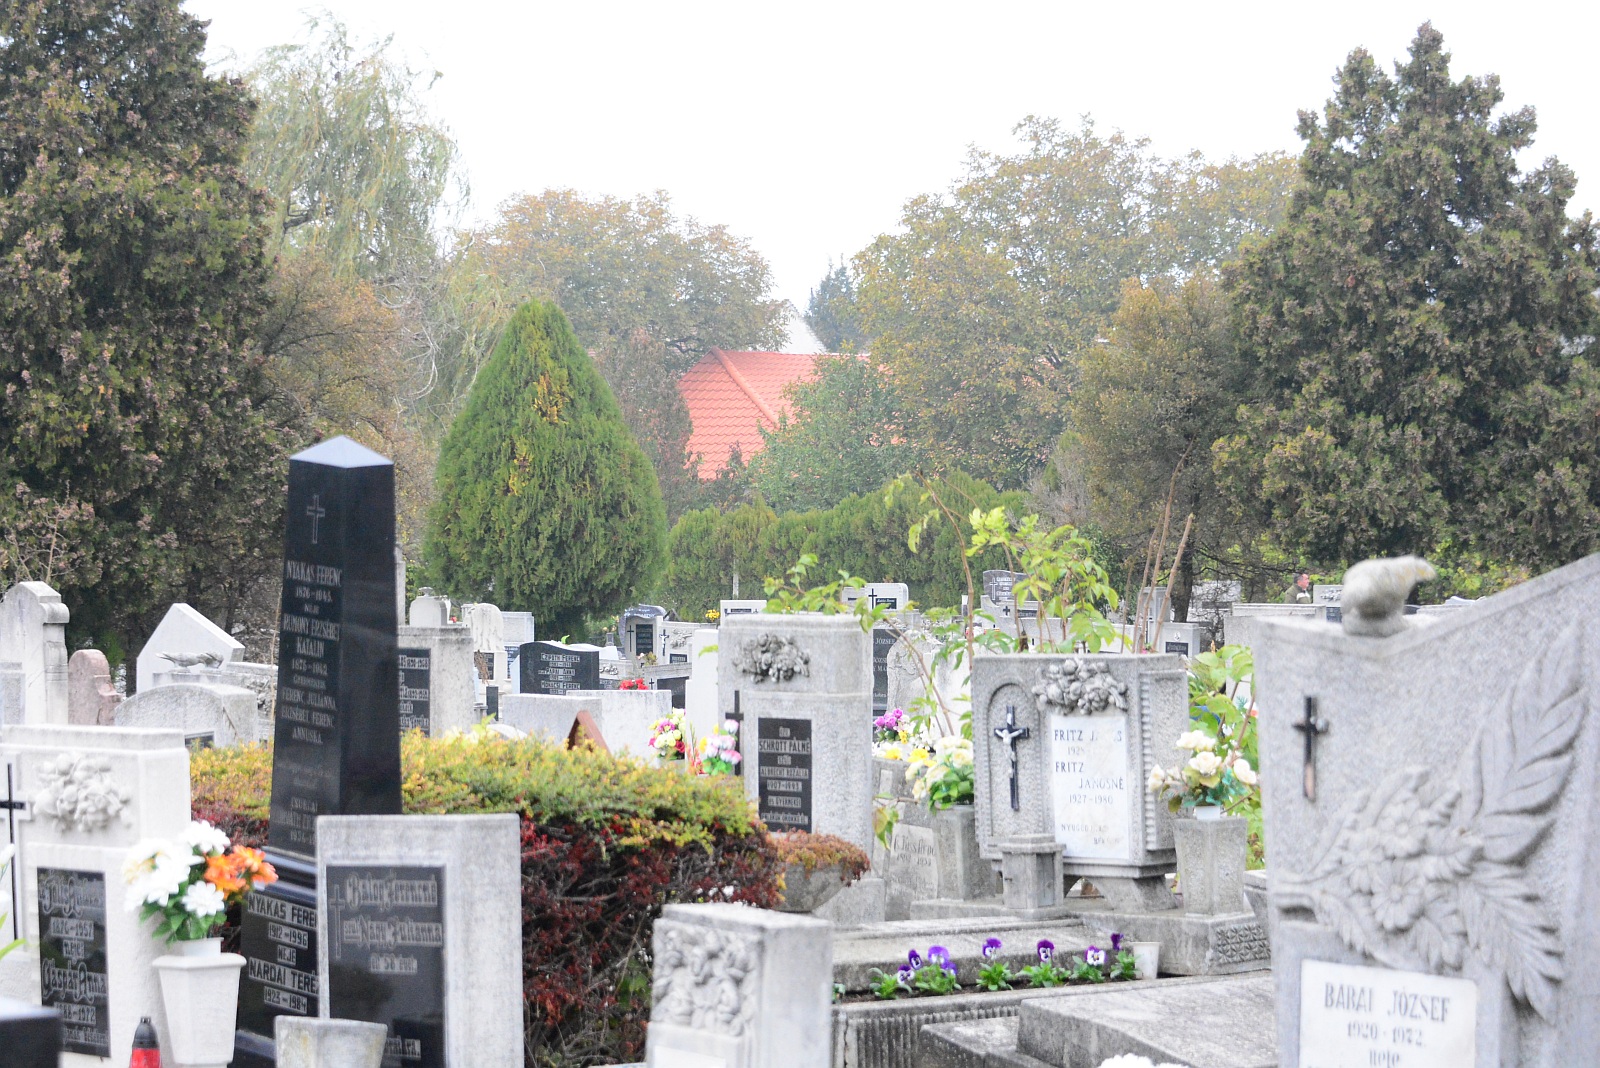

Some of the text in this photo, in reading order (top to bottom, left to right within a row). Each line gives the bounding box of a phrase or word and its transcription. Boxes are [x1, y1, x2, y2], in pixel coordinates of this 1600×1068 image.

[286, 560, 342, 588] NYAKAS FERENC
[296, 637, 325, 658] KATALIN
[759, 737, 811, 754] SCHROTT PÁLNÉ
[1054, 729, 1083, 742] FRITZ
[1055, 761, 1084, 773] FRITZ
[248, 893, 287, 919] NYAKAS
[269, 923, 308, 949] 1912-1996
[277, 945, 297, 966] NEJE
[74, 962, 107, 1004] Anna
[249, 958, 319, 996] NARDAI TERÉ
[1387, 986, 1451, 1023] JÓZSEF
